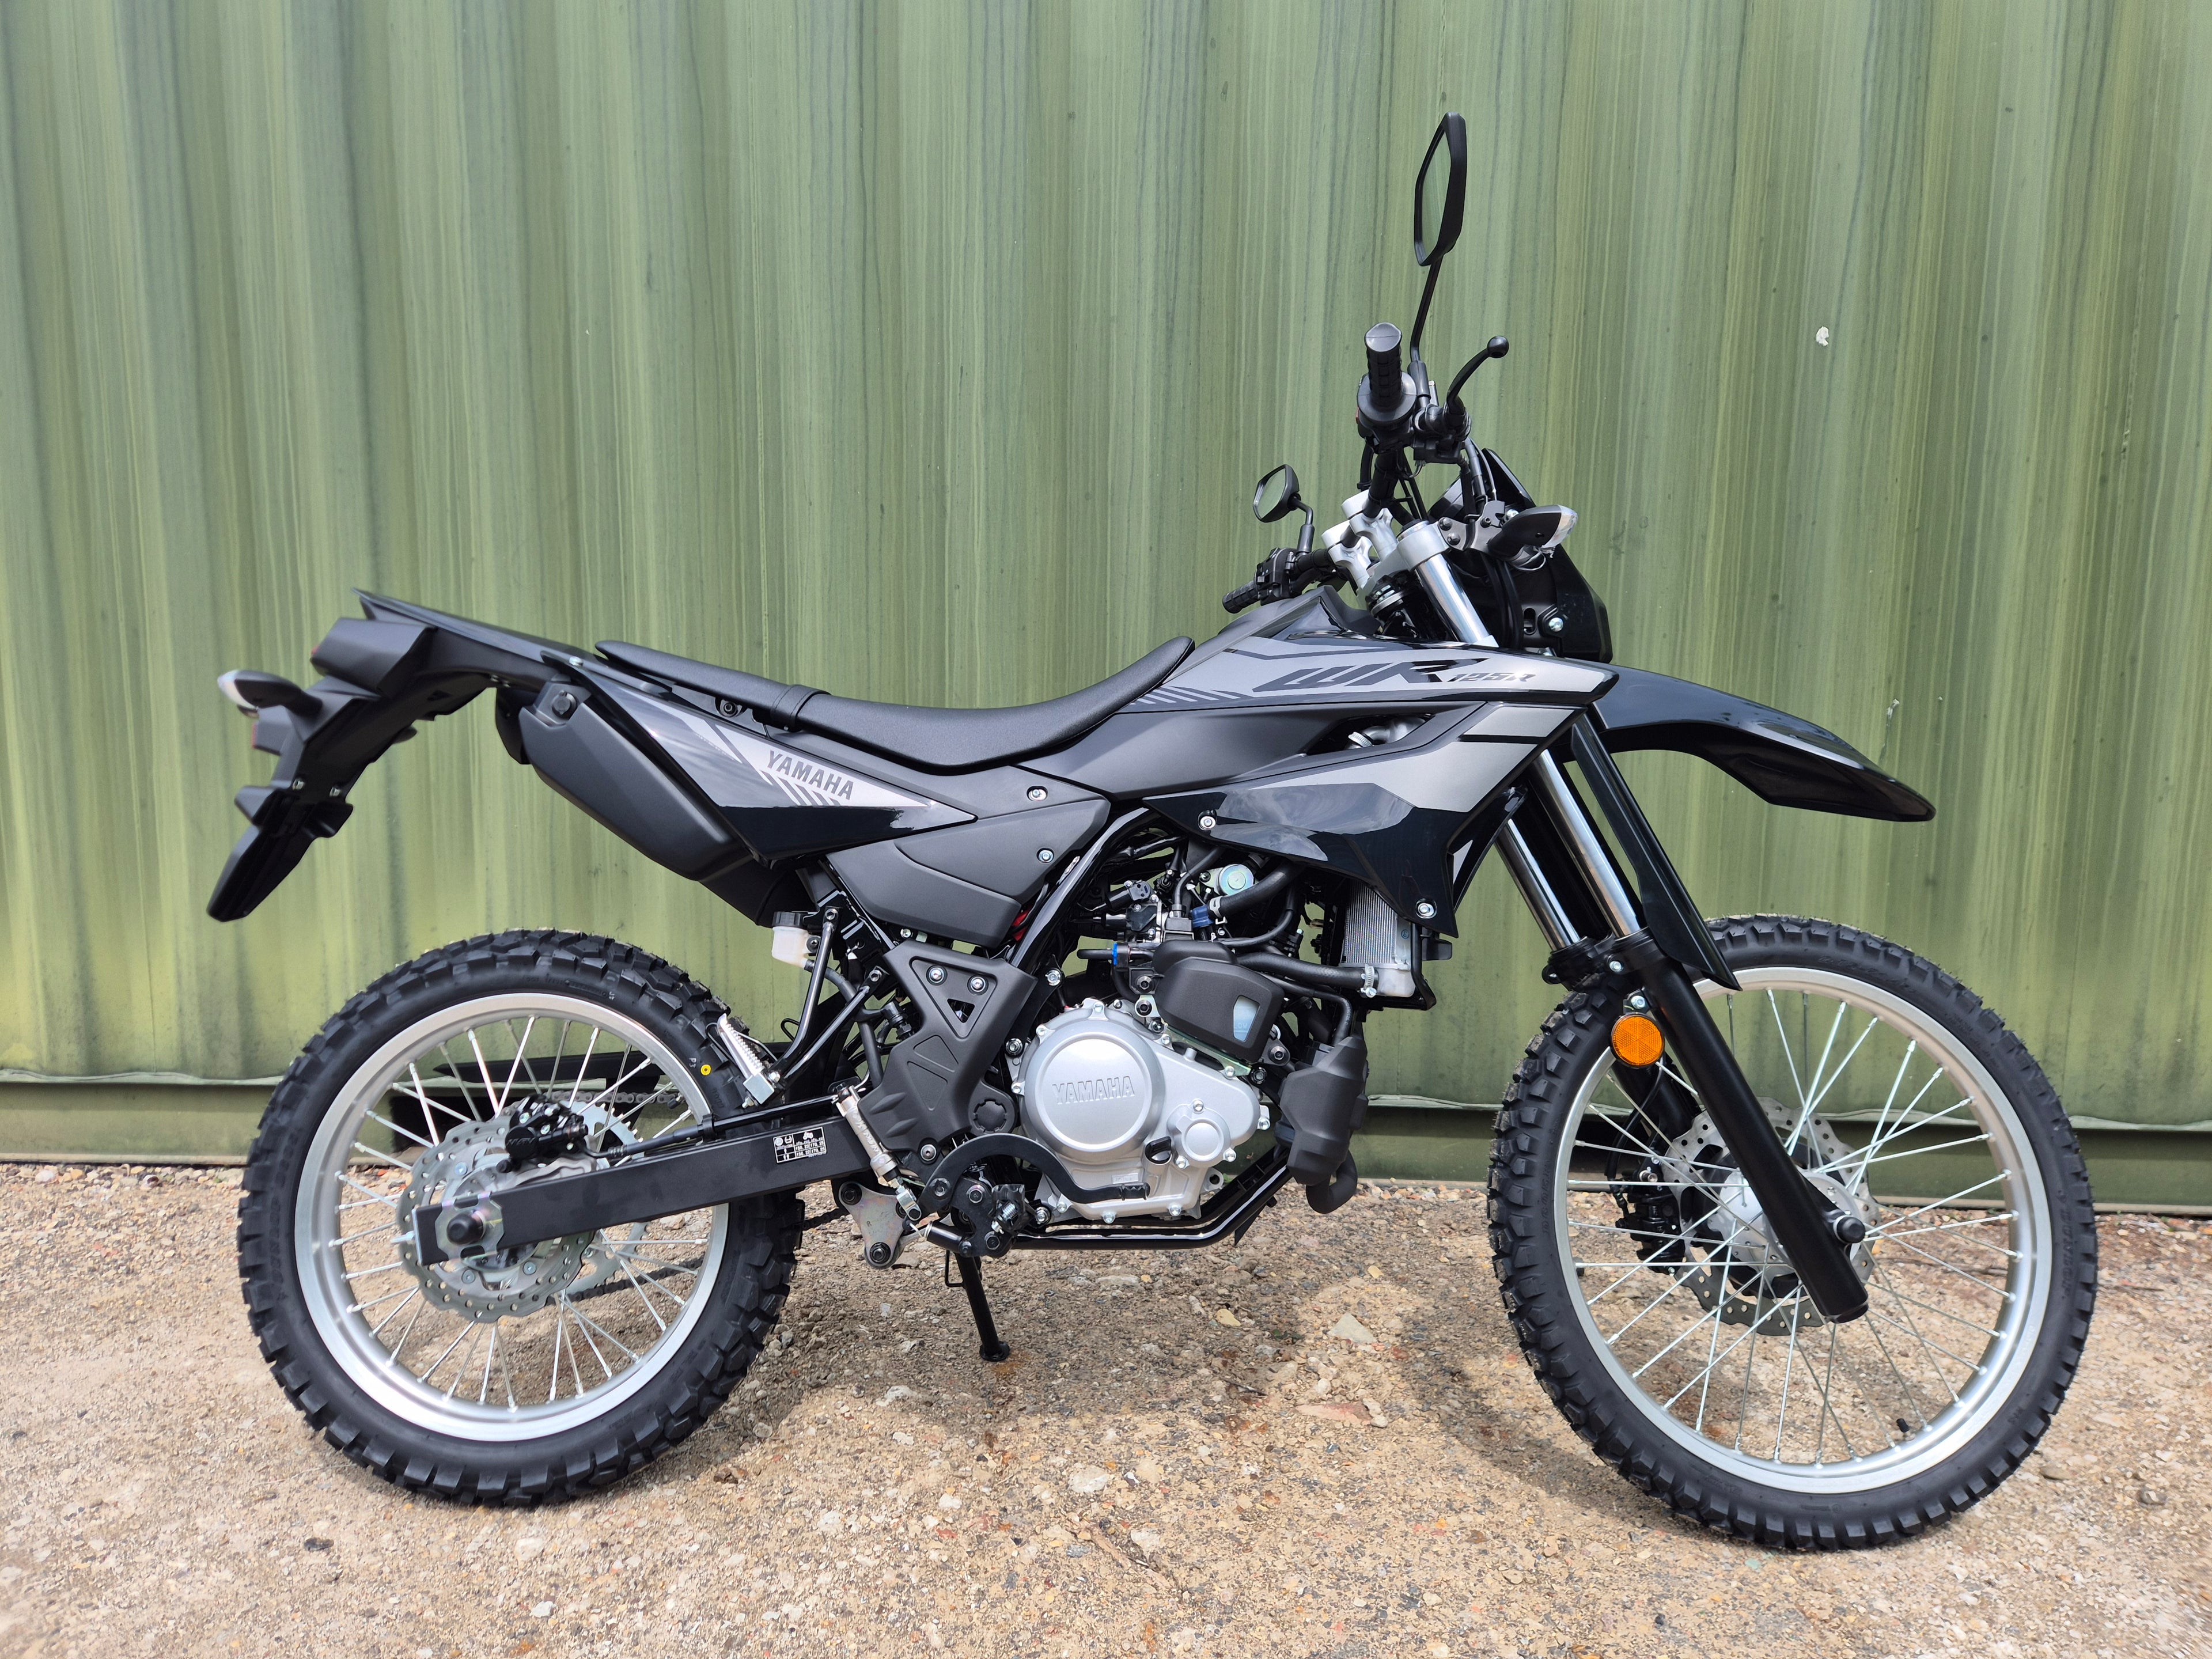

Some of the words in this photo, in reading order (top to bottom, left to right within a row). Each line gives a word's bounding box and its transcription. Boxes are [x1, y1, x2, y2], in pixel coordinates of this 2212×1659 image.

[1252, 658, 1491, 692] WR
[1447, 672, 1536, 683] 125R
[767, 751, 854, 800] YAMAHA
[1052, 1076, 1135, 1105] YAMAHA
